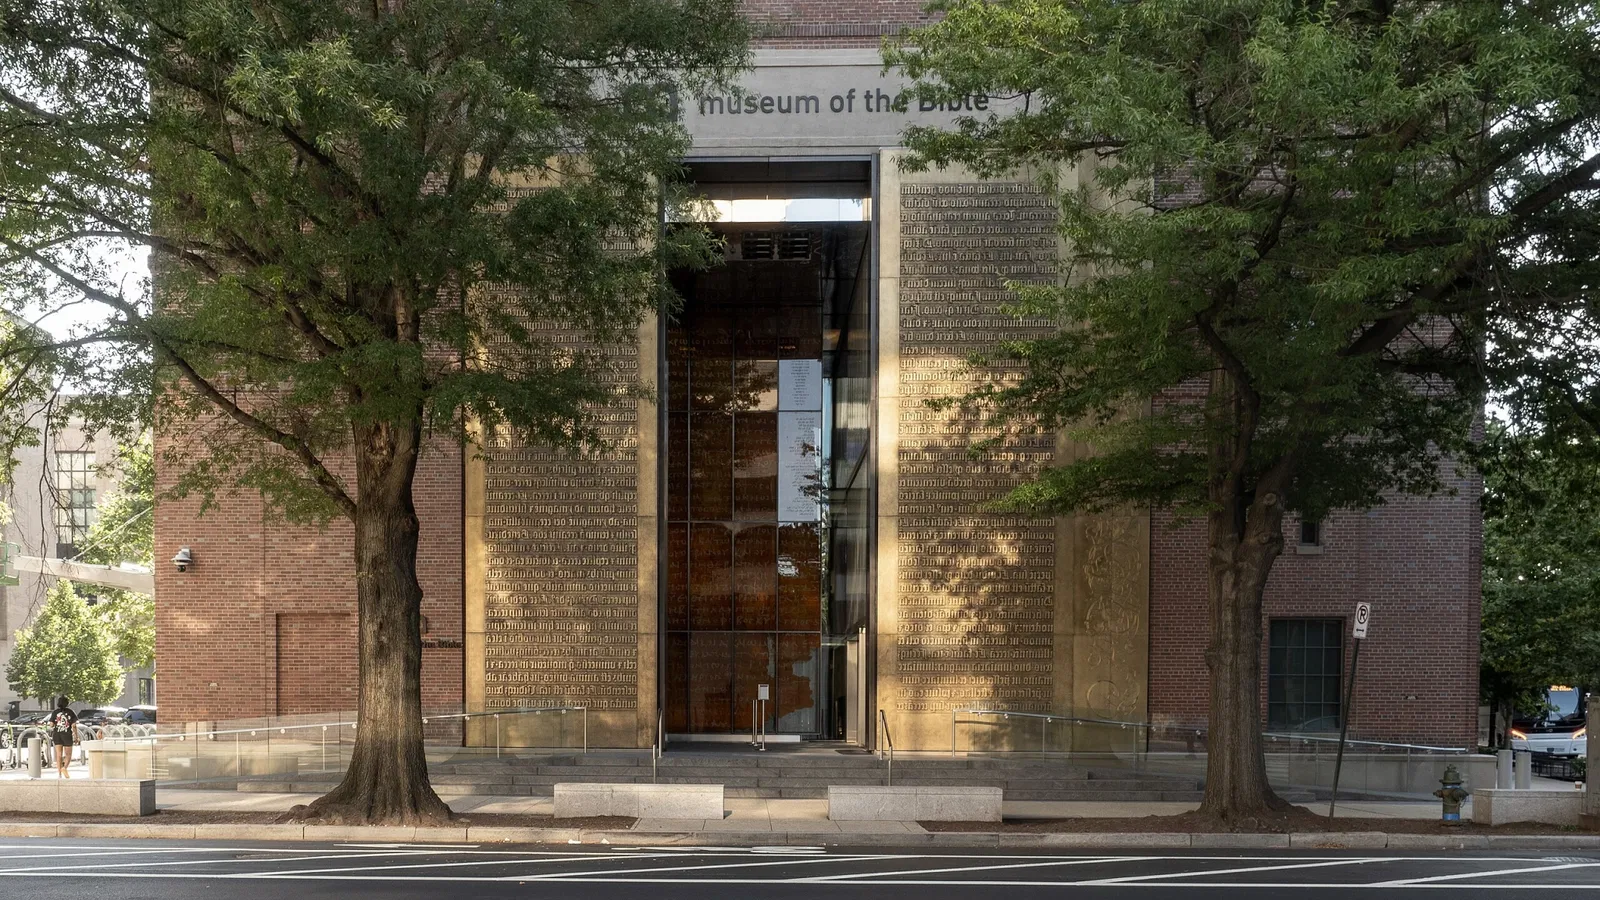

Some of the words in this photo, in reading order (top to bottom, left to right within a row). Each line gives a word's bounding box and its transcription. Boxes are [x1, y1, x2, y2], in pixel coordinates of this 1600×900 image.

[700, 94, 819, 114] museum
[830, 88, 856, 113] of
[864, 88, 907, 112] the
